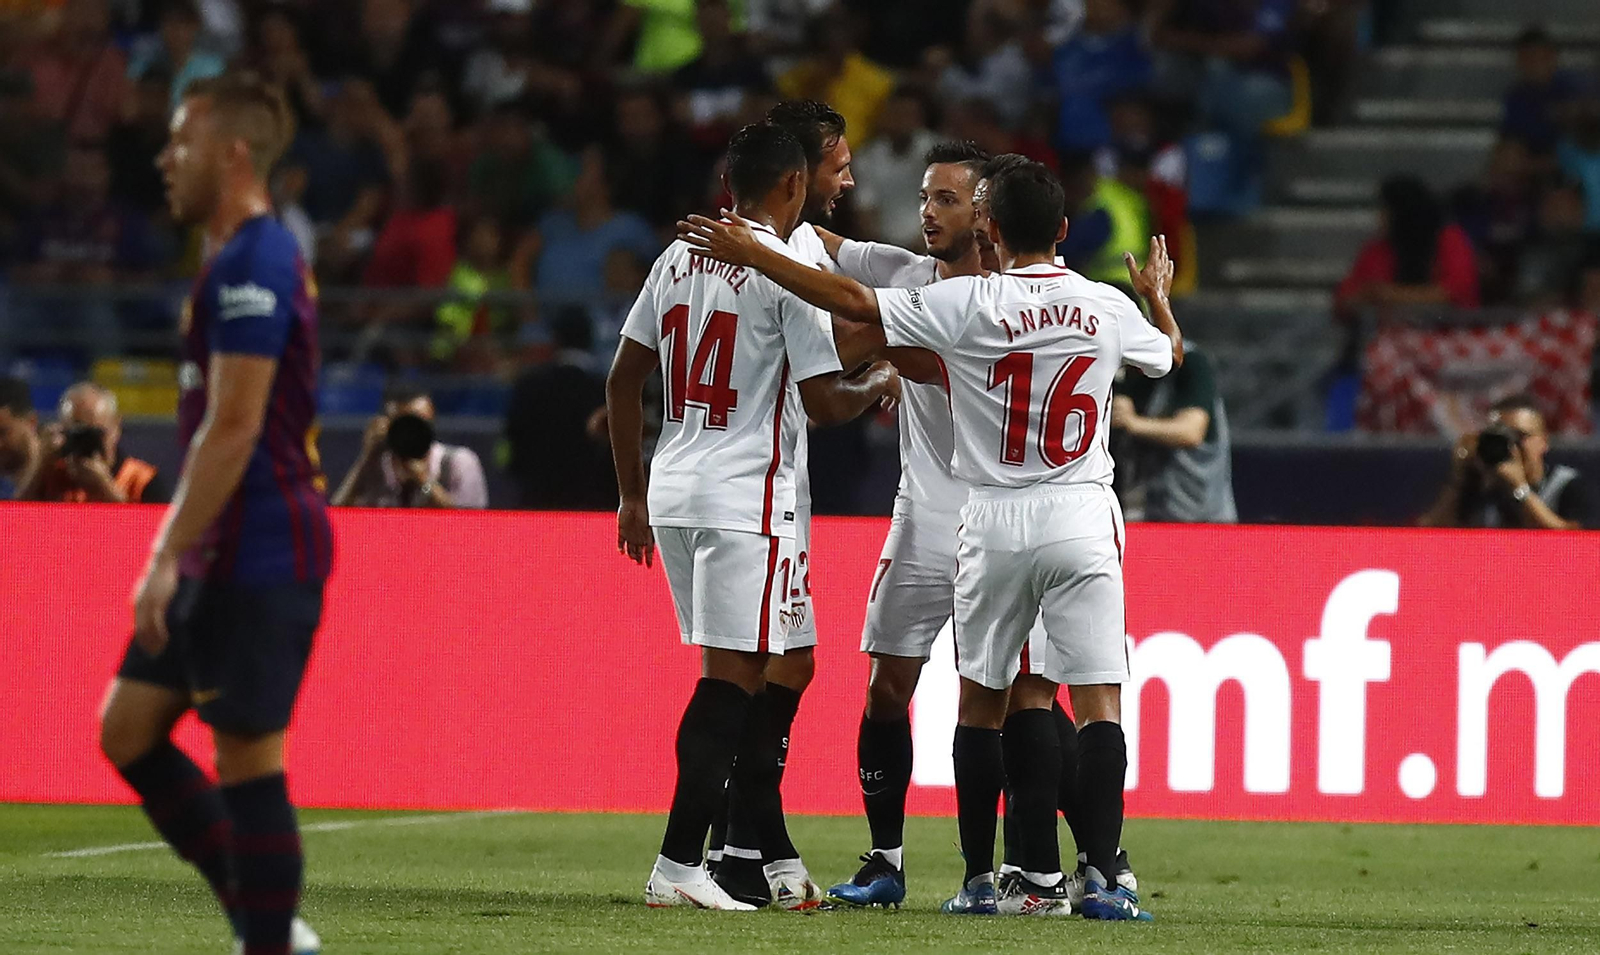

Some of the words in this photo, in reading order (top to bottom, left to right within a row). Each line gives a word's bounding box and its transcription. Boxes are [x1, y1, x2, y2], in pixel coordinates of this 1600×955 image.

[660, 303, 739, 431] 14
[986, 351, 1098, 470] 16
[869, 558, 893, 604] 7
[911, 568, 1600, 799] mf.m
[859, 767, 884, 782] SFC
